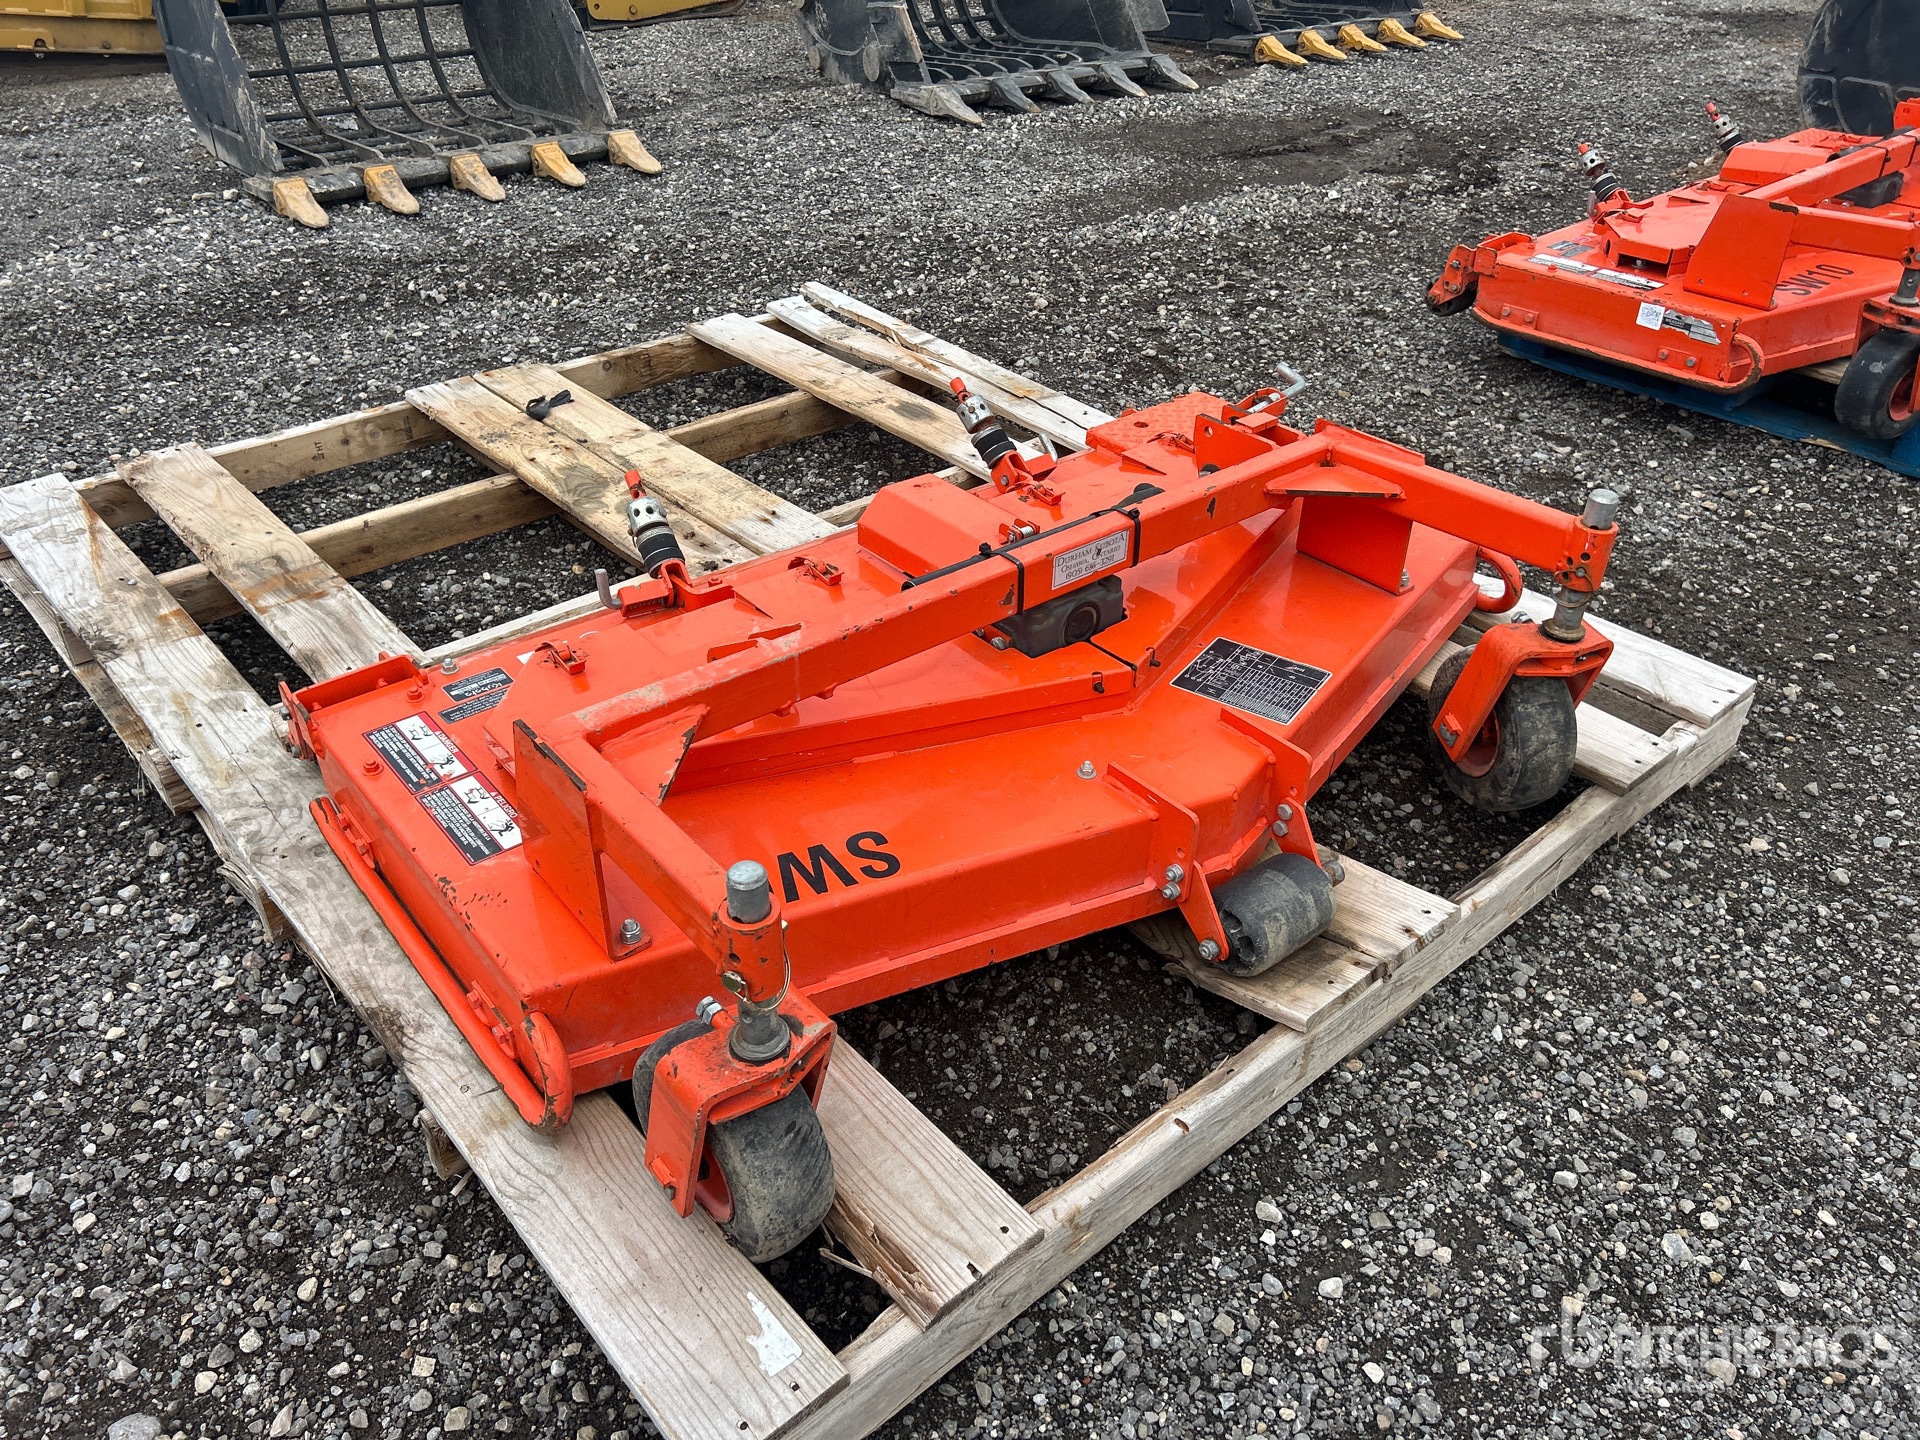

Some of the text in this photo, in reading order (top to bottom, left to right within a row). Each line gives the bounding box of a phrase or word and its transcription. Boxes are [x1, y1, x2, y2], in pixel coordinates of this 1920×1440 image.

[1776, 264, 1855, 296] SW10
[1057, 547, 1092, 567] DURHAM
[438, 732, 459, 753] DANGER
[494, 795, 518, 819] PELIGRO
